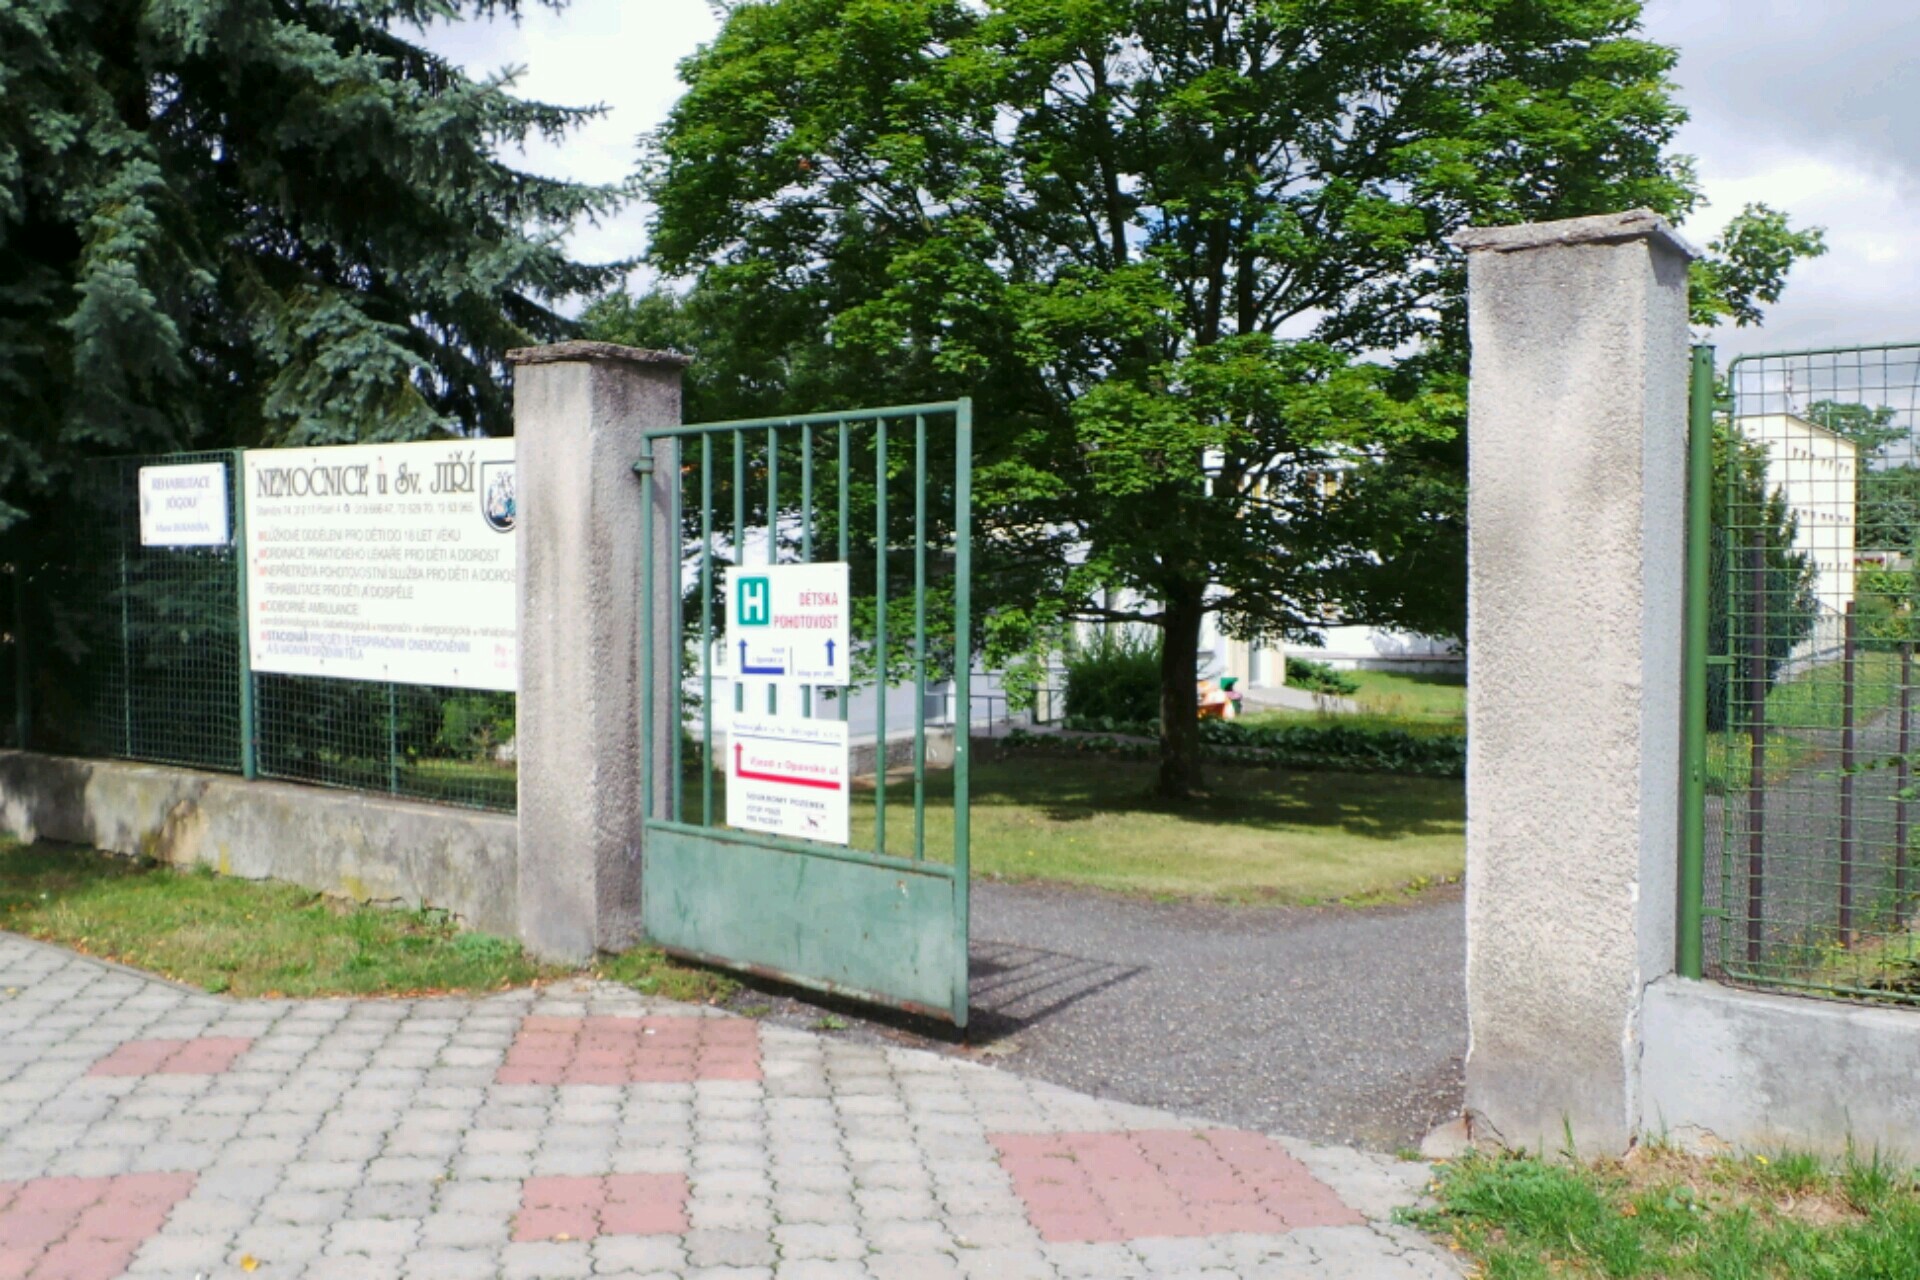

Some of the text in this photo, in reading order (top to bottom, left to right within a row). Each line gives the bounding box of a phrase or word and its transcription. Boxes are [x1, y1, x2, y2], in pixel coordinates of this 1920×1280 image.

[257, 464, 368, 497] NEMOCNICE
[395, 462, 421, 494] Sv.
[430, 450, 475, 494] JIŘÍ
[345, 529, 363, 541] PRO
[388, 529, 402, 541] DO
[417, 529, 432, 541] LET
[404, 548, 424, 561] PRO
[426, 545, 447, 562] DĚTI
[450, 549, 457, 561] A
[458, 549, 501, 562] DOROST
[426, 568, 446, 581] PRO
[448, 565, 469, 581] DĚTI
[472, 569, 479, 581] A
[323, 583, 341, 596] PRO
[743, 583, 764, 621] H
[773, 615, 838, 630] POHOTOVOST
